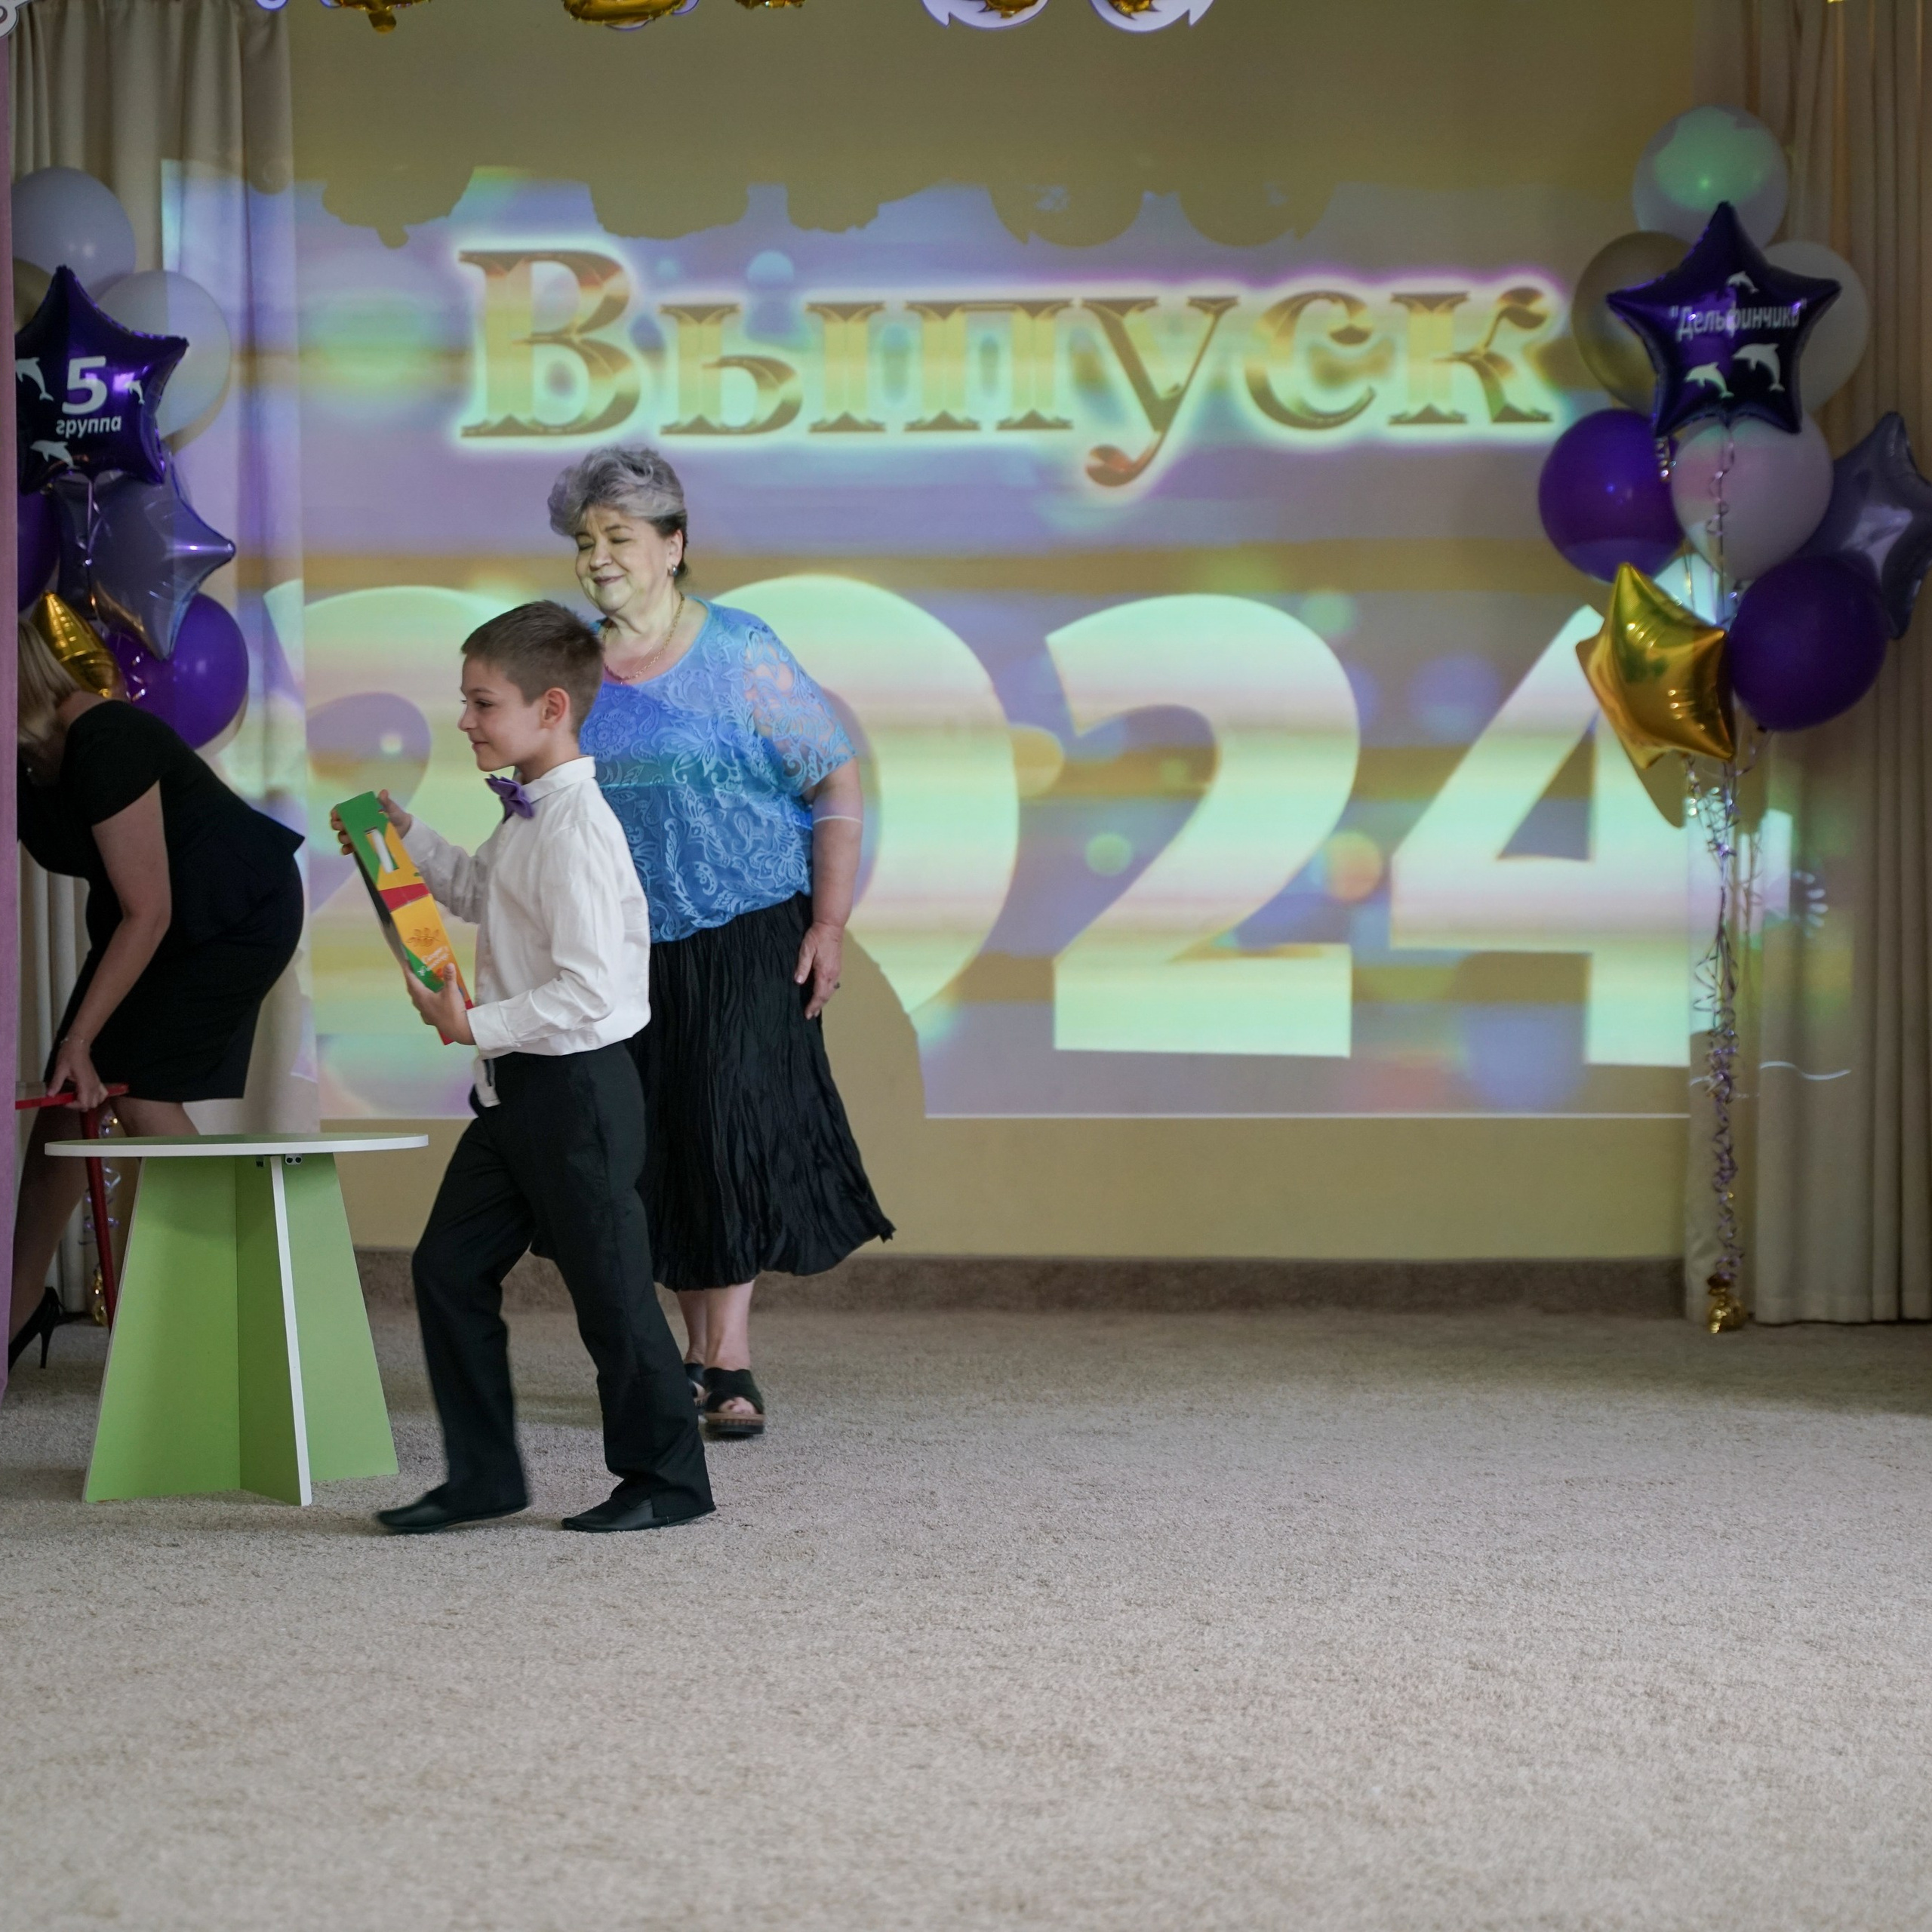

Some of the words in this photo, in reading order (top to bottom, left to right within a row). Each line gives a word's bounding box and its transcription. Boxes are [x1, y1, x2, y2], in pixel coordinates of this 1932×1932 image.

[61, 355, 108, 416] 5
[456, 246, 1562, 489] Выпуск
[55, 415, 122, 438] группа
